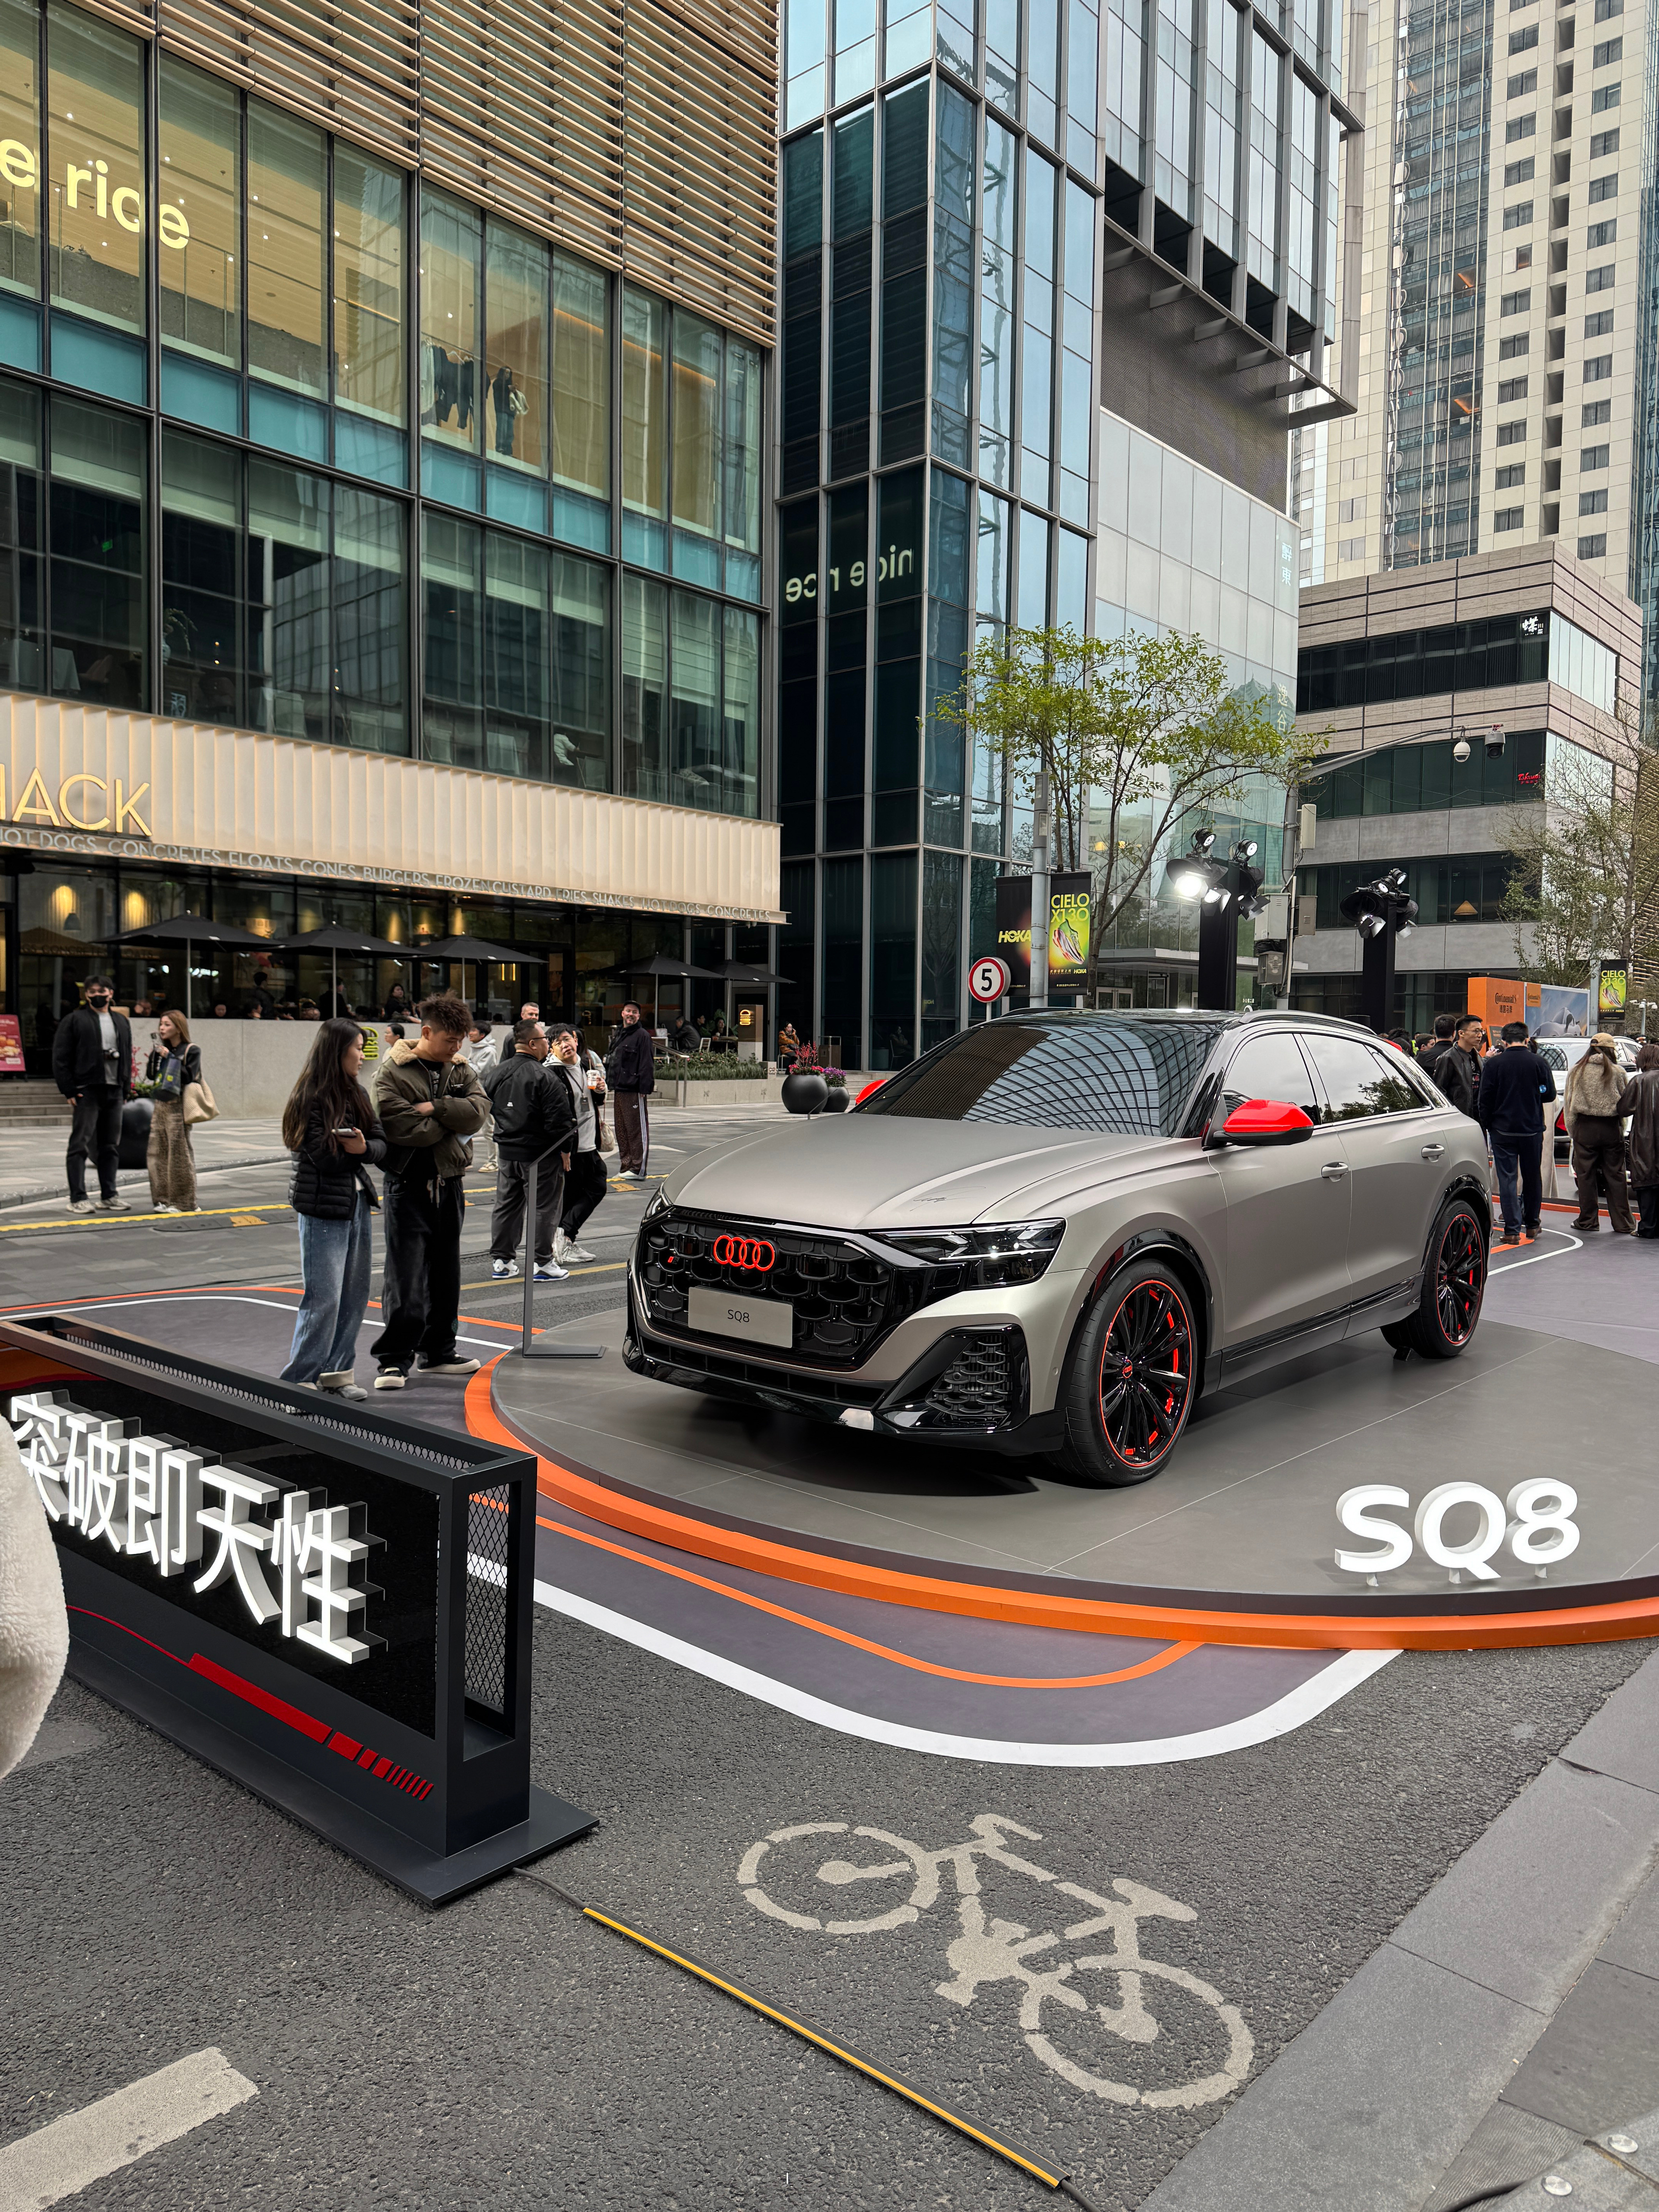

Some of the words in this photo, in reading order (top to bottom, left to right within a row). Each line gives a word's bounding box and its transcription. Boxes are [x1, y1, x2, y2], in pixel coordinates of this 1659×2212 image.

[67, 160, 189, 249] rice
[0, 763, 152, 836] ACK
[0, 827, 34, 847] OT
[40, 832, 97, 852] DOGS
[108, 840, 221, 864] CONCRETES
[228, 852, 293, 871] FLOATS
[300, 860, 357, 877] CONES
[363, 866, 429, 886] BURGERS
[435, 874, 490, 891] FROZEN
[493, 881, 551, 898] CUSTARD
[555, 888, 587, 903] FRIES
[592, 892, 634, 908] SHAKES
[642, 898, 666, 911] HOT
[670, 901, 700, 915] DOGS
[707, 905, 771, 921] CONCRETES
[1051, 893, 1090, 908] CIELO
[998, 930, 1032, 943] HOKA
[981, 968, 993, 992] 5
[1601, 970, 1626, 978] CIELO
[1495, 992, 1514, 1004] Continental
[727, 1309, 750, 1323] SQ8
[12, 1392, 370, 1664] 突破即天性
[1334, 1477, 1580, 1580] SQ8
